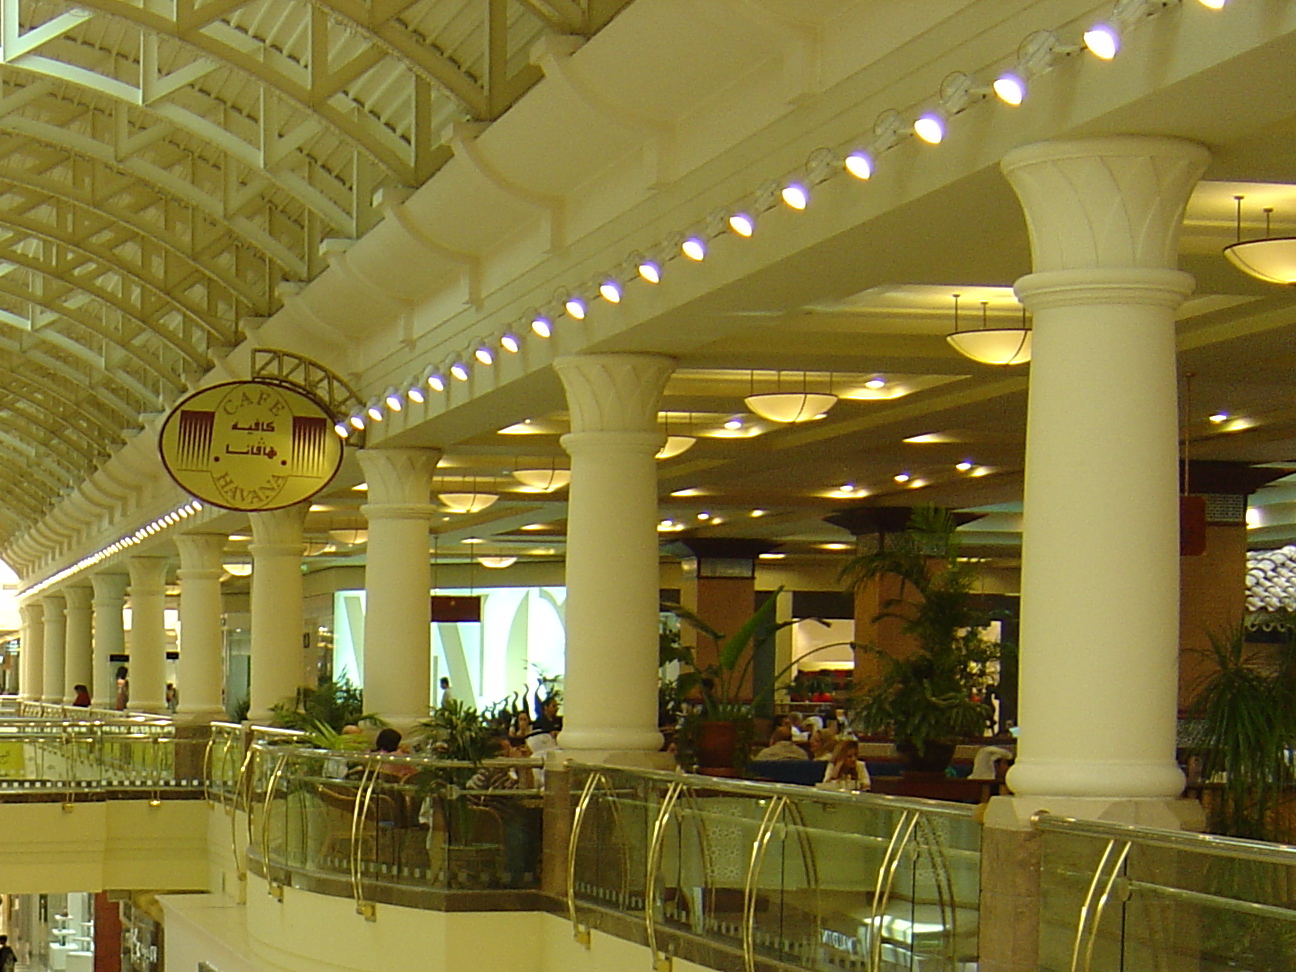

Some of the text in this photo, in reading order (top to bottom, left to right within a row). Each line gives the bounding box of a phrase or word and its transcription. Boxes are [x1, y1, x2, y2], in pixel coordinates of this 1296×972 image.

[223, 391, 285, 416] CAFE
[232, 418, 275, 434] كافيه
[216, 472, 285, 504] HAVANA
